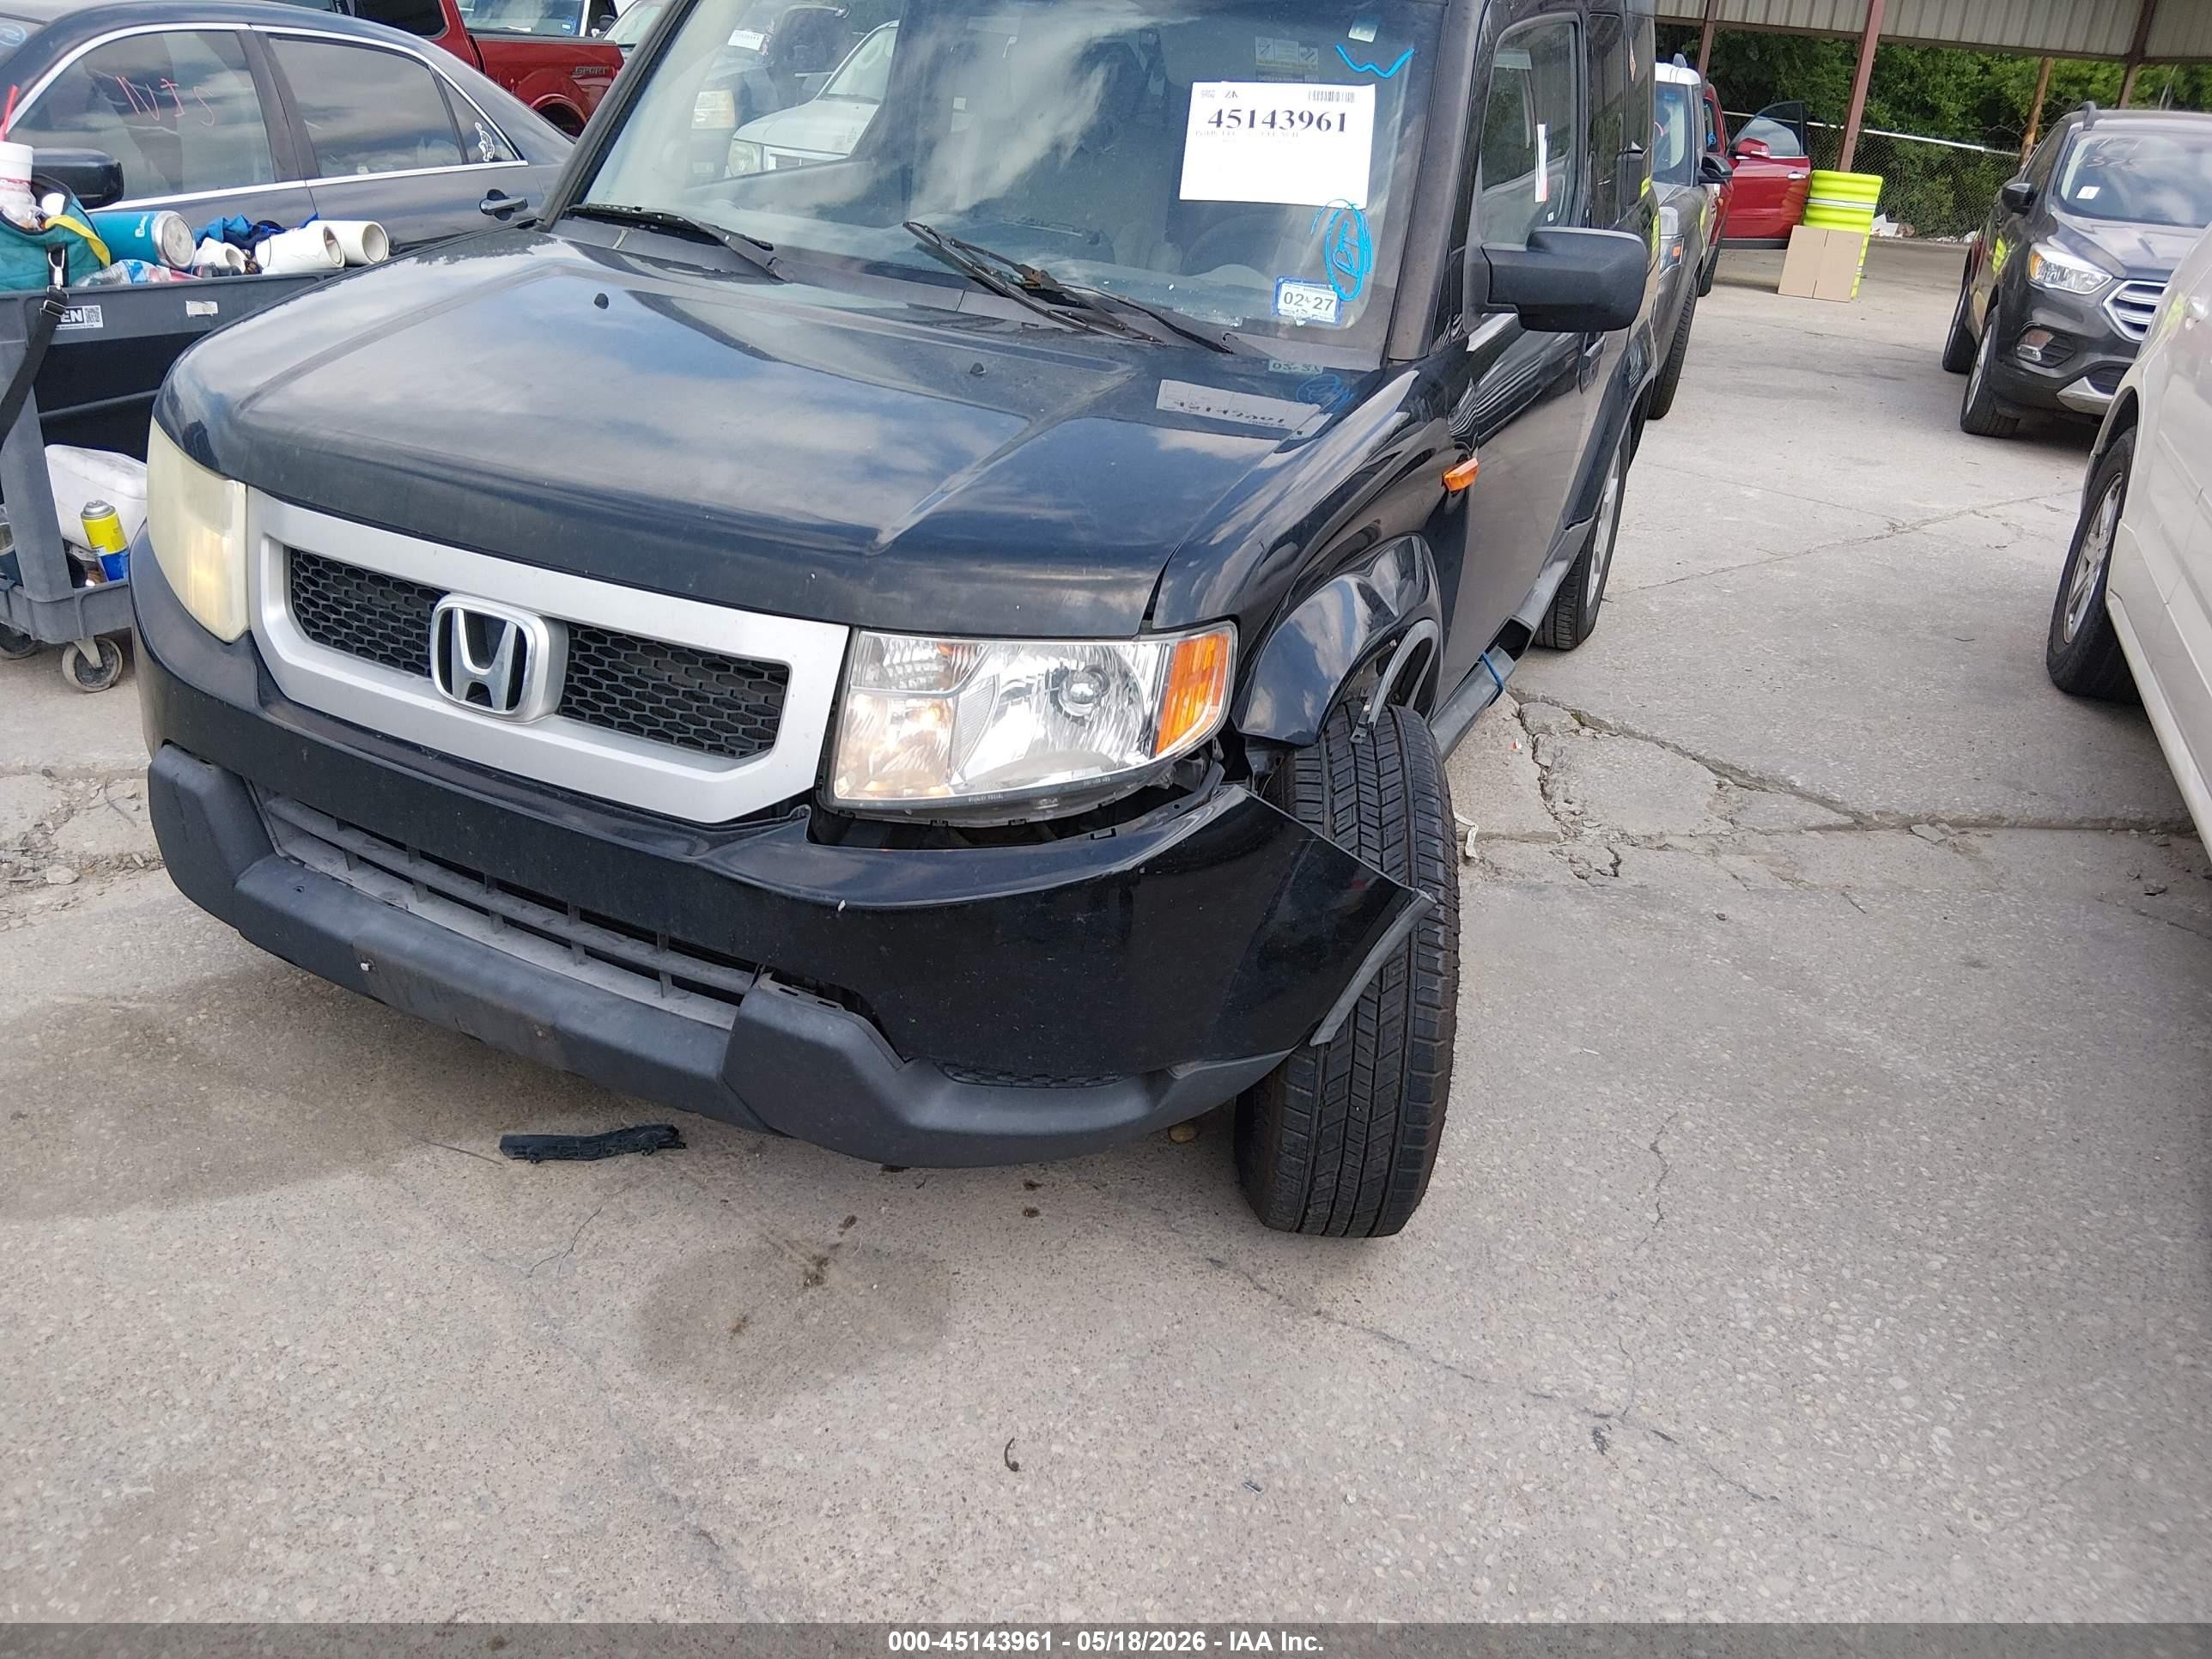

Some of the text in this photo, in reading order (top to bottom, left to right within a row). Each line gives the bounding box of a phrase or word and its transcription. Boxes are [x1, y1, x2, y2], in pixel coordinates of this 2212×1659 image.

[573, 65, 606, 77] SPORT
[1207, 108, 1347, 132] 45143961
[1284, 292, 1334, 312] 02 27
[59, 309, 84, 323] EN
